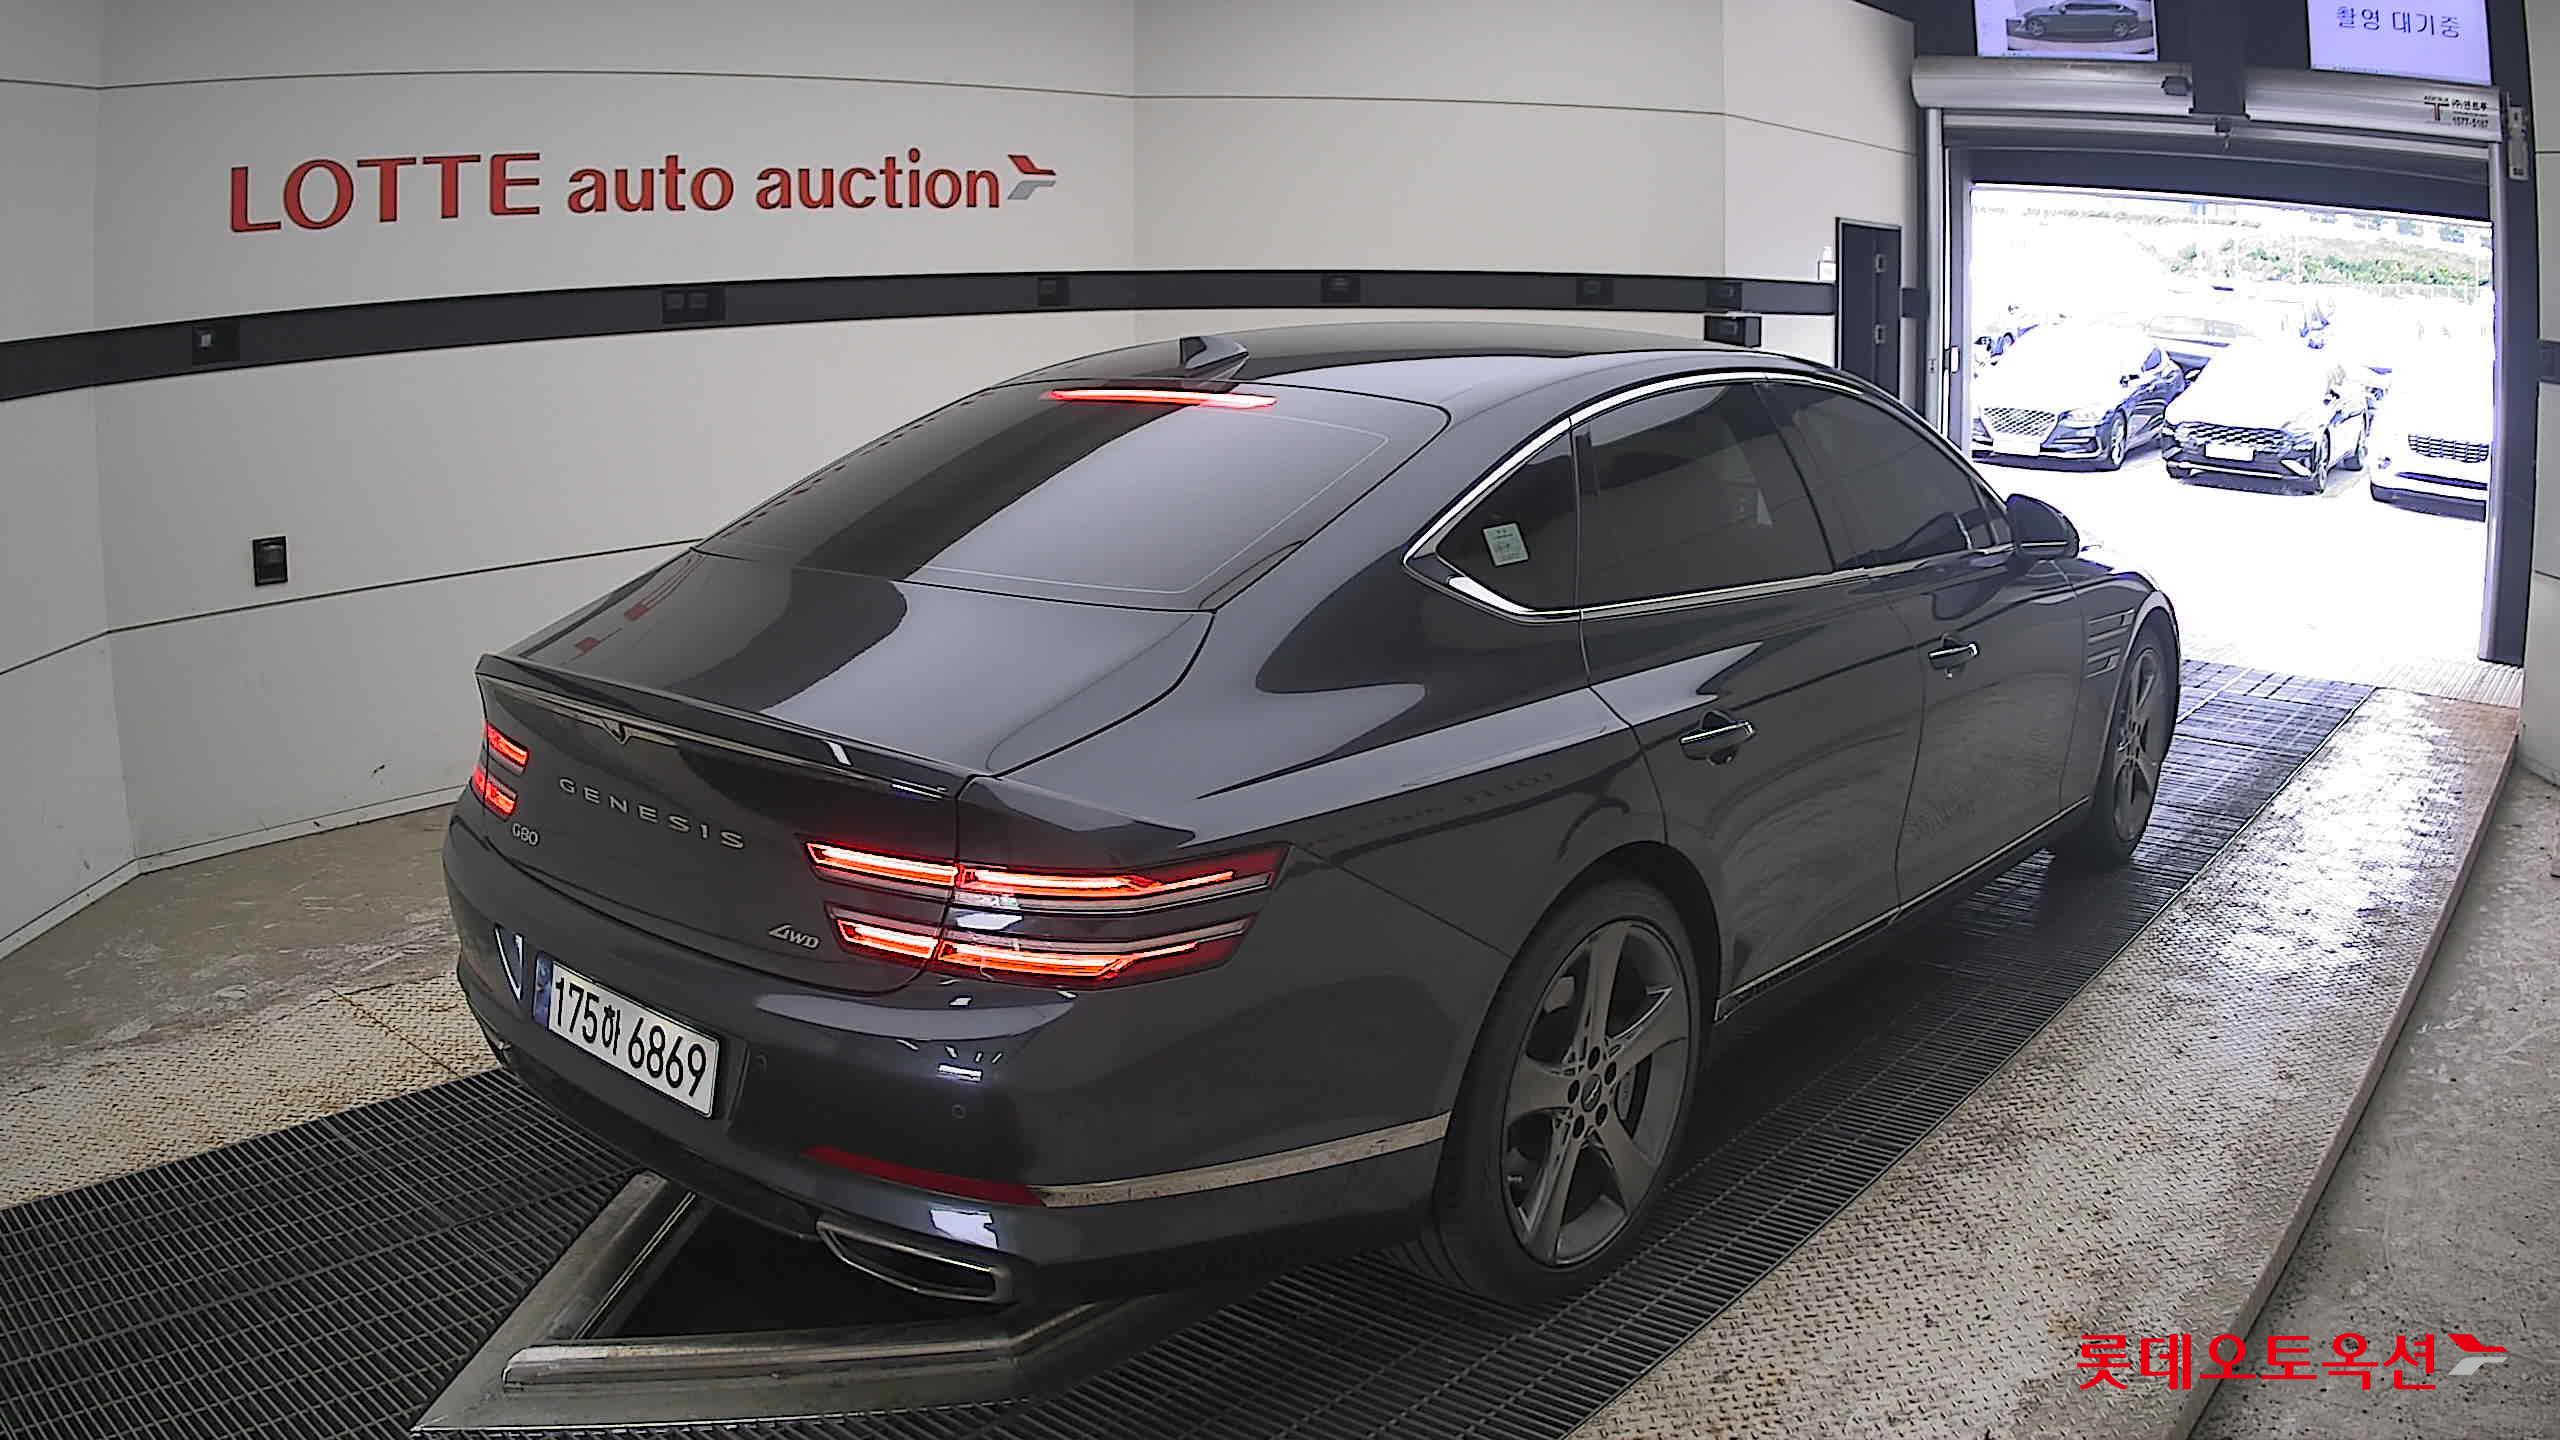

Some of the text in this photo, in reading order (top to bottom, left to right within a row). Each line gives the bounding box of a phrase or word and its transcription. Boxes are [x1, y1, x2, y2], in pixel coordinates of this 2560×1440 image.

[2336, 5, 2460, 39] 촬영 대기중
[229, 147, 1001, 233] LOTTE auto auction
[512, 823, 539, 846] G80
[558, 777, 744, 849] GENESIS
[768, 923, 820, 949] 4WD
[555, 976, 706, 1097] 175하 6869
